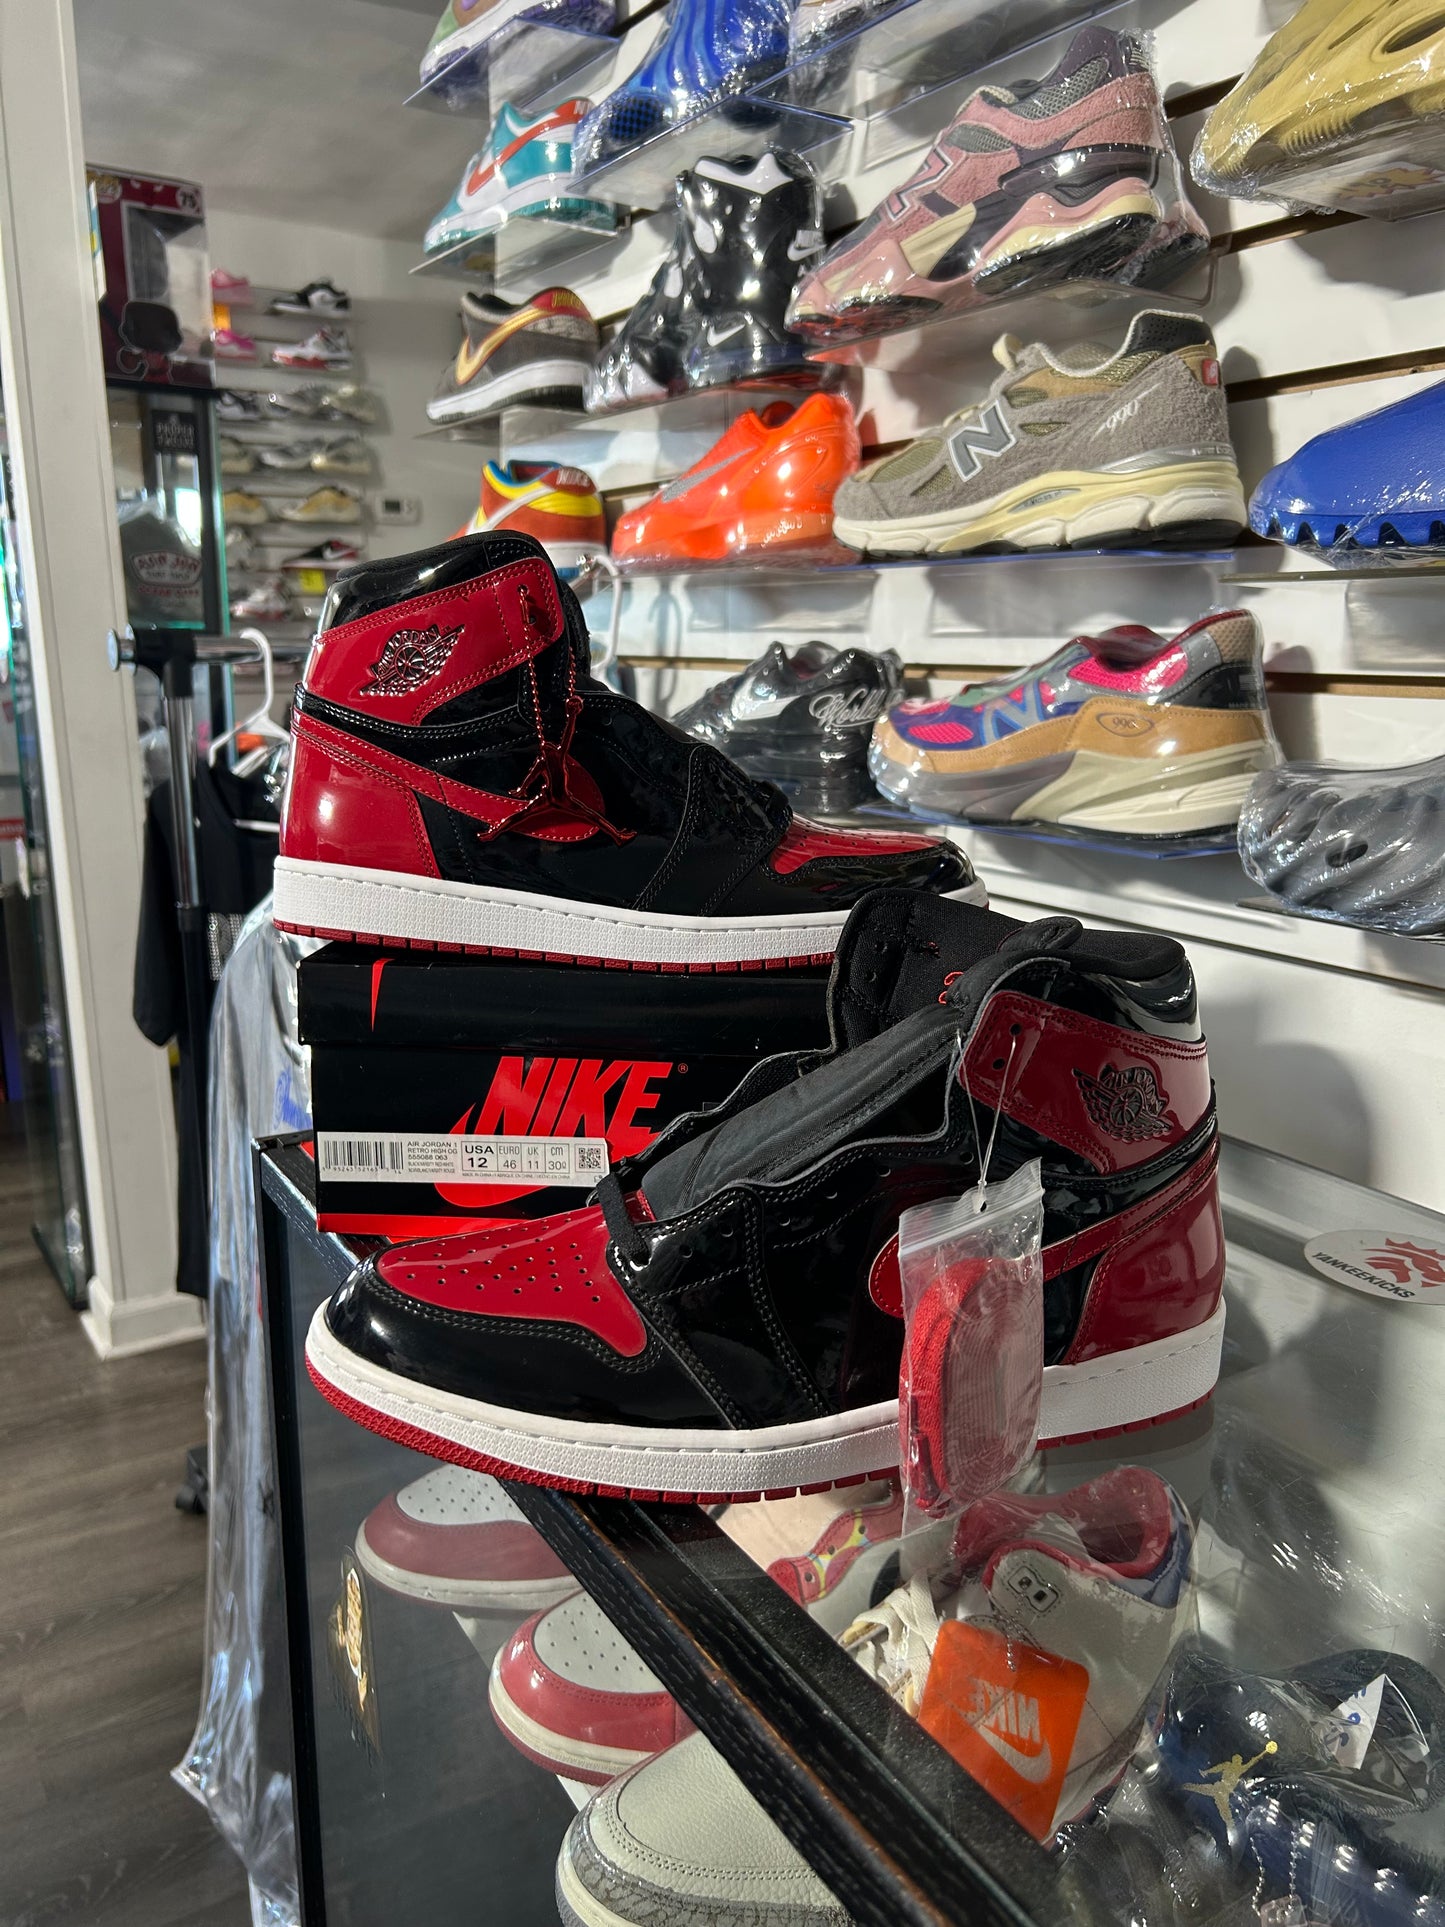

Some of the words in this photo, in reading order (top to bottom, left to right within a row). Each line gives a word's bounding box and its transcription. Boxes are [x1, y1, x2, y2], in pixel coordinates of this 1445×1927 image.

[949, 399, 1016, 482] N
[556, 468, 591, 487] NIKE
[474, 1056, 673, 1139] NIKE
[465, 1145, 494, 1154] USA
[499, 1145, 520, 1156] EURO
[528, 1146, 539, 1156] UK
[468, 1157, 488, 1168] 12
[503, 1160, 517, 1170] 46
[528, 1160, 539, 1170] 11
[1312, 1251, 1415, 1298] YANKEEKICKS
